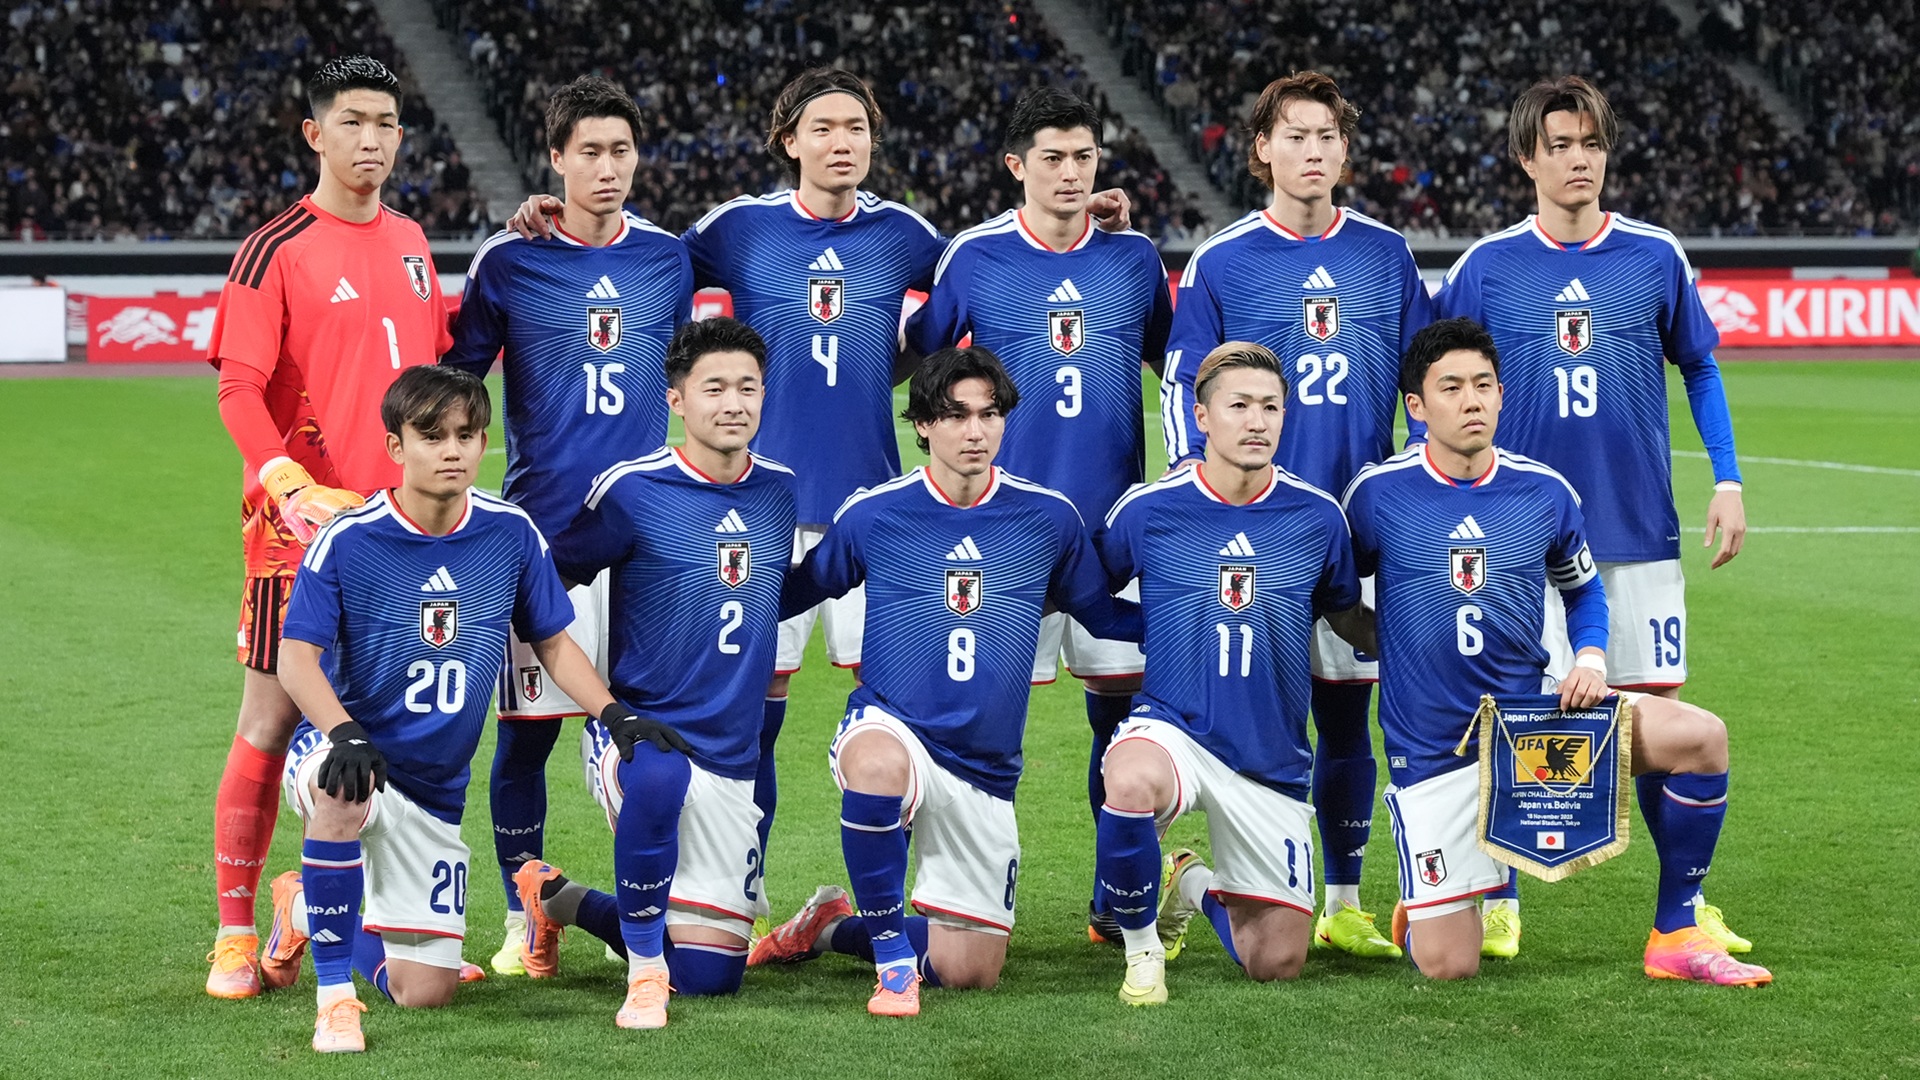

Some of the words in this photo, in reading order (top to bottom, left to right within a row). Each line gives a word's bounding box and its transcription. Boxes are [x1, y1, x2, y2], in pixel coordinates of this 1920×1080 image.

[1768, 288, 1920, 337] KIRIN
[382, 316, 401, 370] 1
[812, 334, 838, 386] 4
[583, 362, 625, 416] 15
[1056, 366, 1082, 418] 3
[1296, 352, 1349, 406] 22
[1554, 366, 1598, 418] 19
[1578, 547, 1592, 574] C
[718, 601, 744, 654] 2
[1216, 622, 1253, 678] 11
[1456, 604, 1484, 656] 6
[1649, 616, 1681, 668] 19
[948, 628, 975, 682] 8
[404, 660, 466, 714] 20
[1503, 713, 1528, 723] Japan
[1529, 712, 1559, 722] Football
[1560, 711, 1608, 721] Association
[1518, 738, 1545, 751] JFA
[494, 822, 541, 836] JAPAN
[1518, 800, 1542, 810] Japan
[217, 852, 265, 867] JAPAN
[620, 875, 672, 891] JAPAN
[1004, 858, 1018, 911] 8
[430, 860, 467, 916] 20
[862, 901, 903, 917] JAPAN
[1101, 878, 1152, 898] JAPAN
